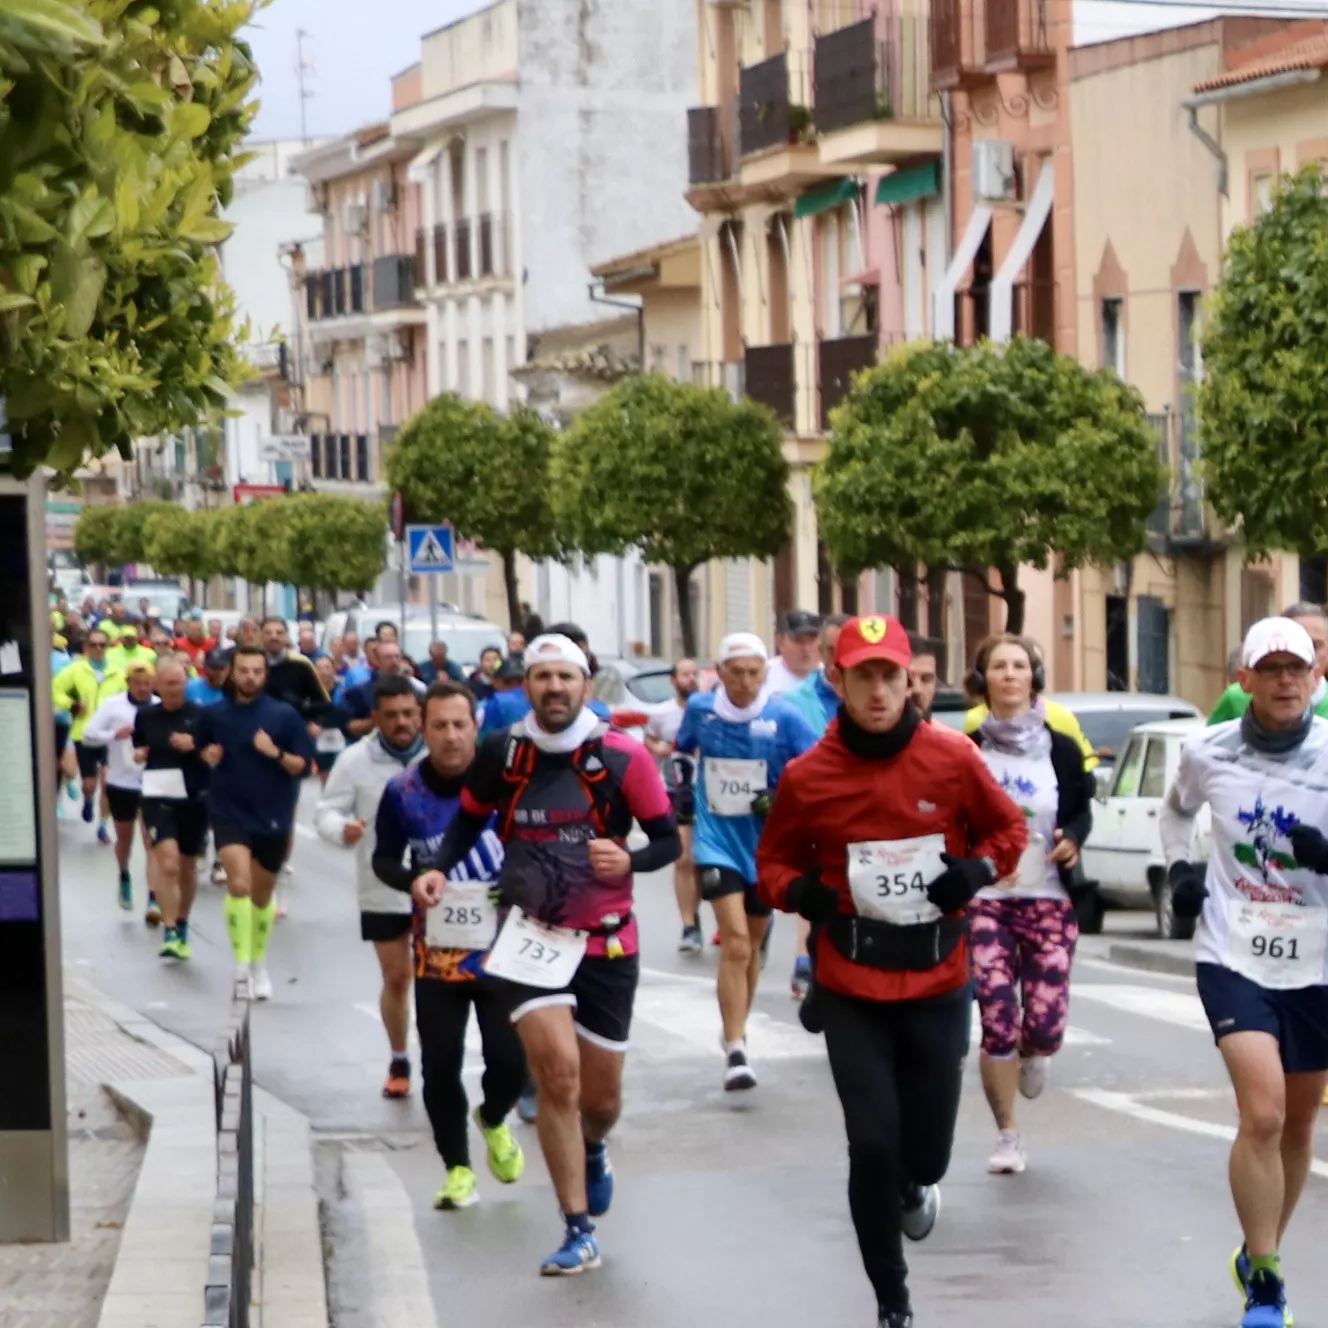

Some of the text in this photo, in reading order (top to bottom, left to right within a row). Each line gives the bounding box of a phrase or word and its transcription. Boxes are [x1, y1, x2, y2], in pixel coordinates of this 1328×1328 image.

[720, 780, 753, 795] 704
[876, 871, 928, 897] 354
[444, 907, 482, 924] 285
[518, 937, 561, 964] 737
[1251, 935, 1300, 960] 961
